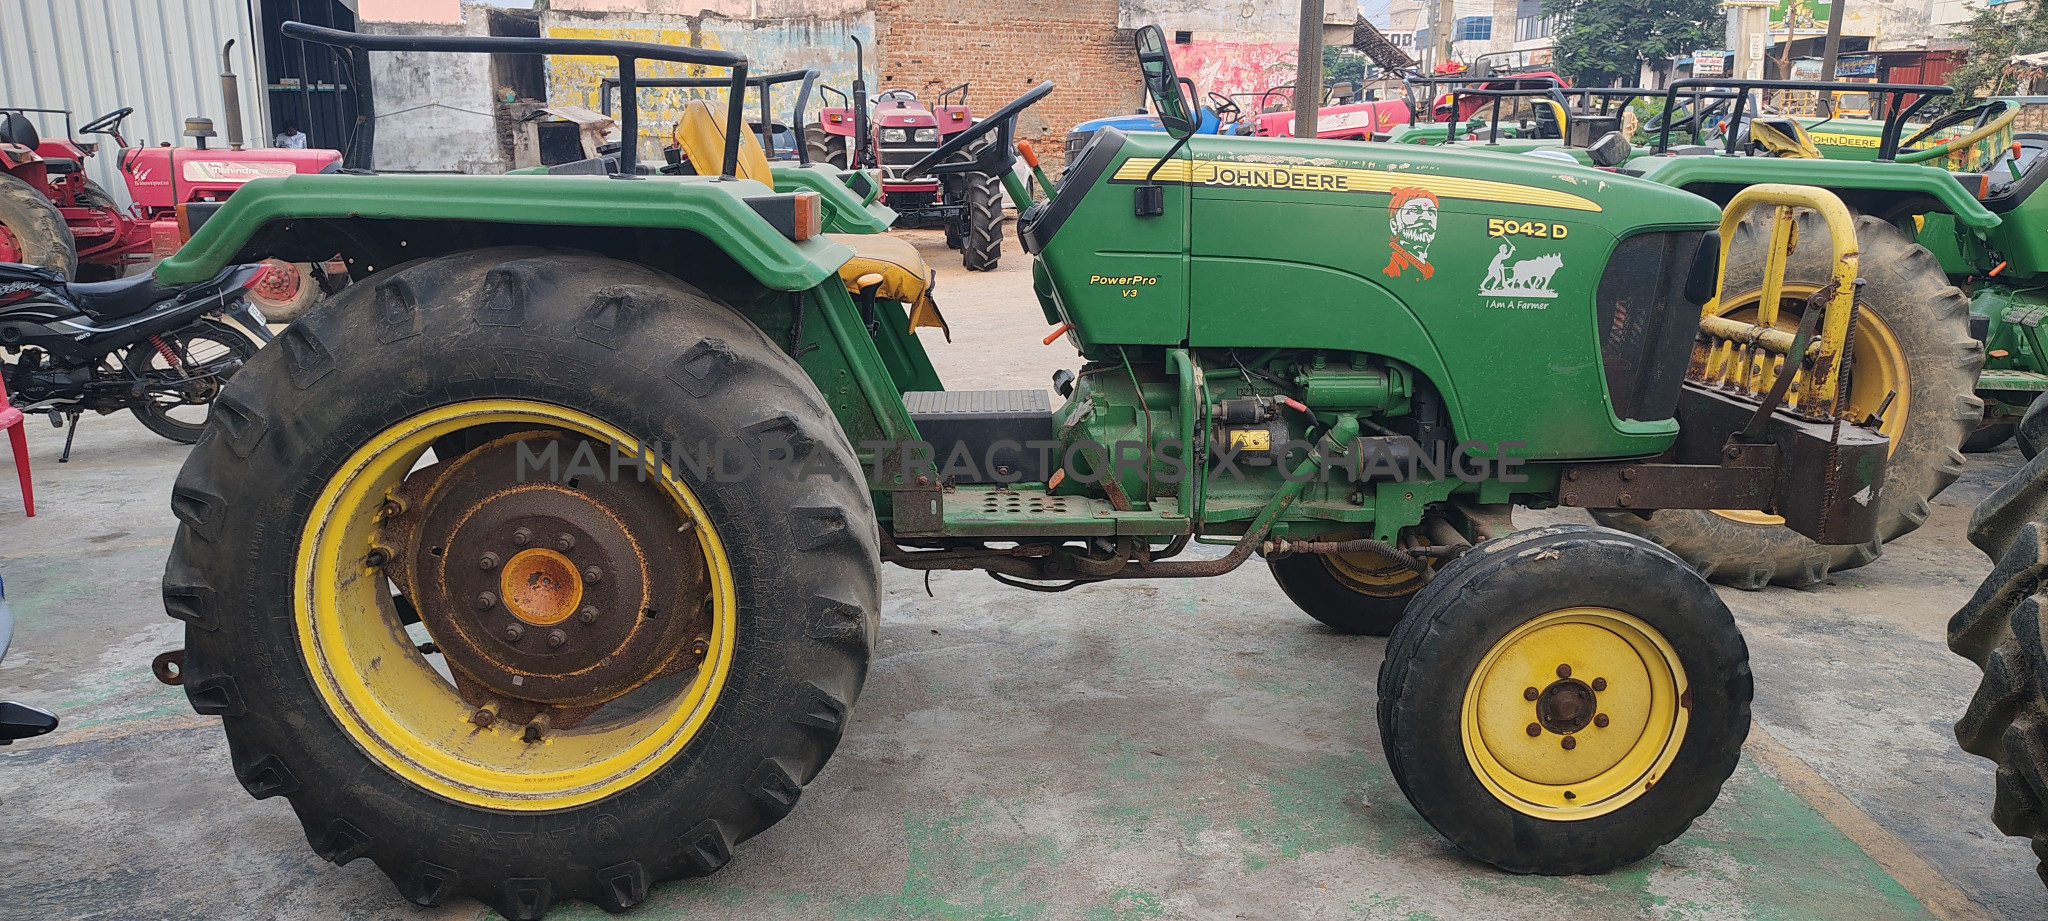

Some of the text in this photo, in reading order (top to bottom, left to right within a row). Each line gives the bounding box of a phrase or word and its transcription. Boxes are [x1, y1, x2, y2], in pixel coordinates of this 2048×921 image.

[1810, 134, 1876, 147] JOHN DEERE
[1205, 165, 1349, 190] JOHN DEERE
[1488, 218, 1568, 240] 5042 D
[1089, 274, 1157, 286] PowerPro
[1122, 289, 1138, 298] V3
[1490, 300, 1505, 309] Am
[1507, 300, 1515, 309] A
[1517, 300, 1549, 310] Farmer
